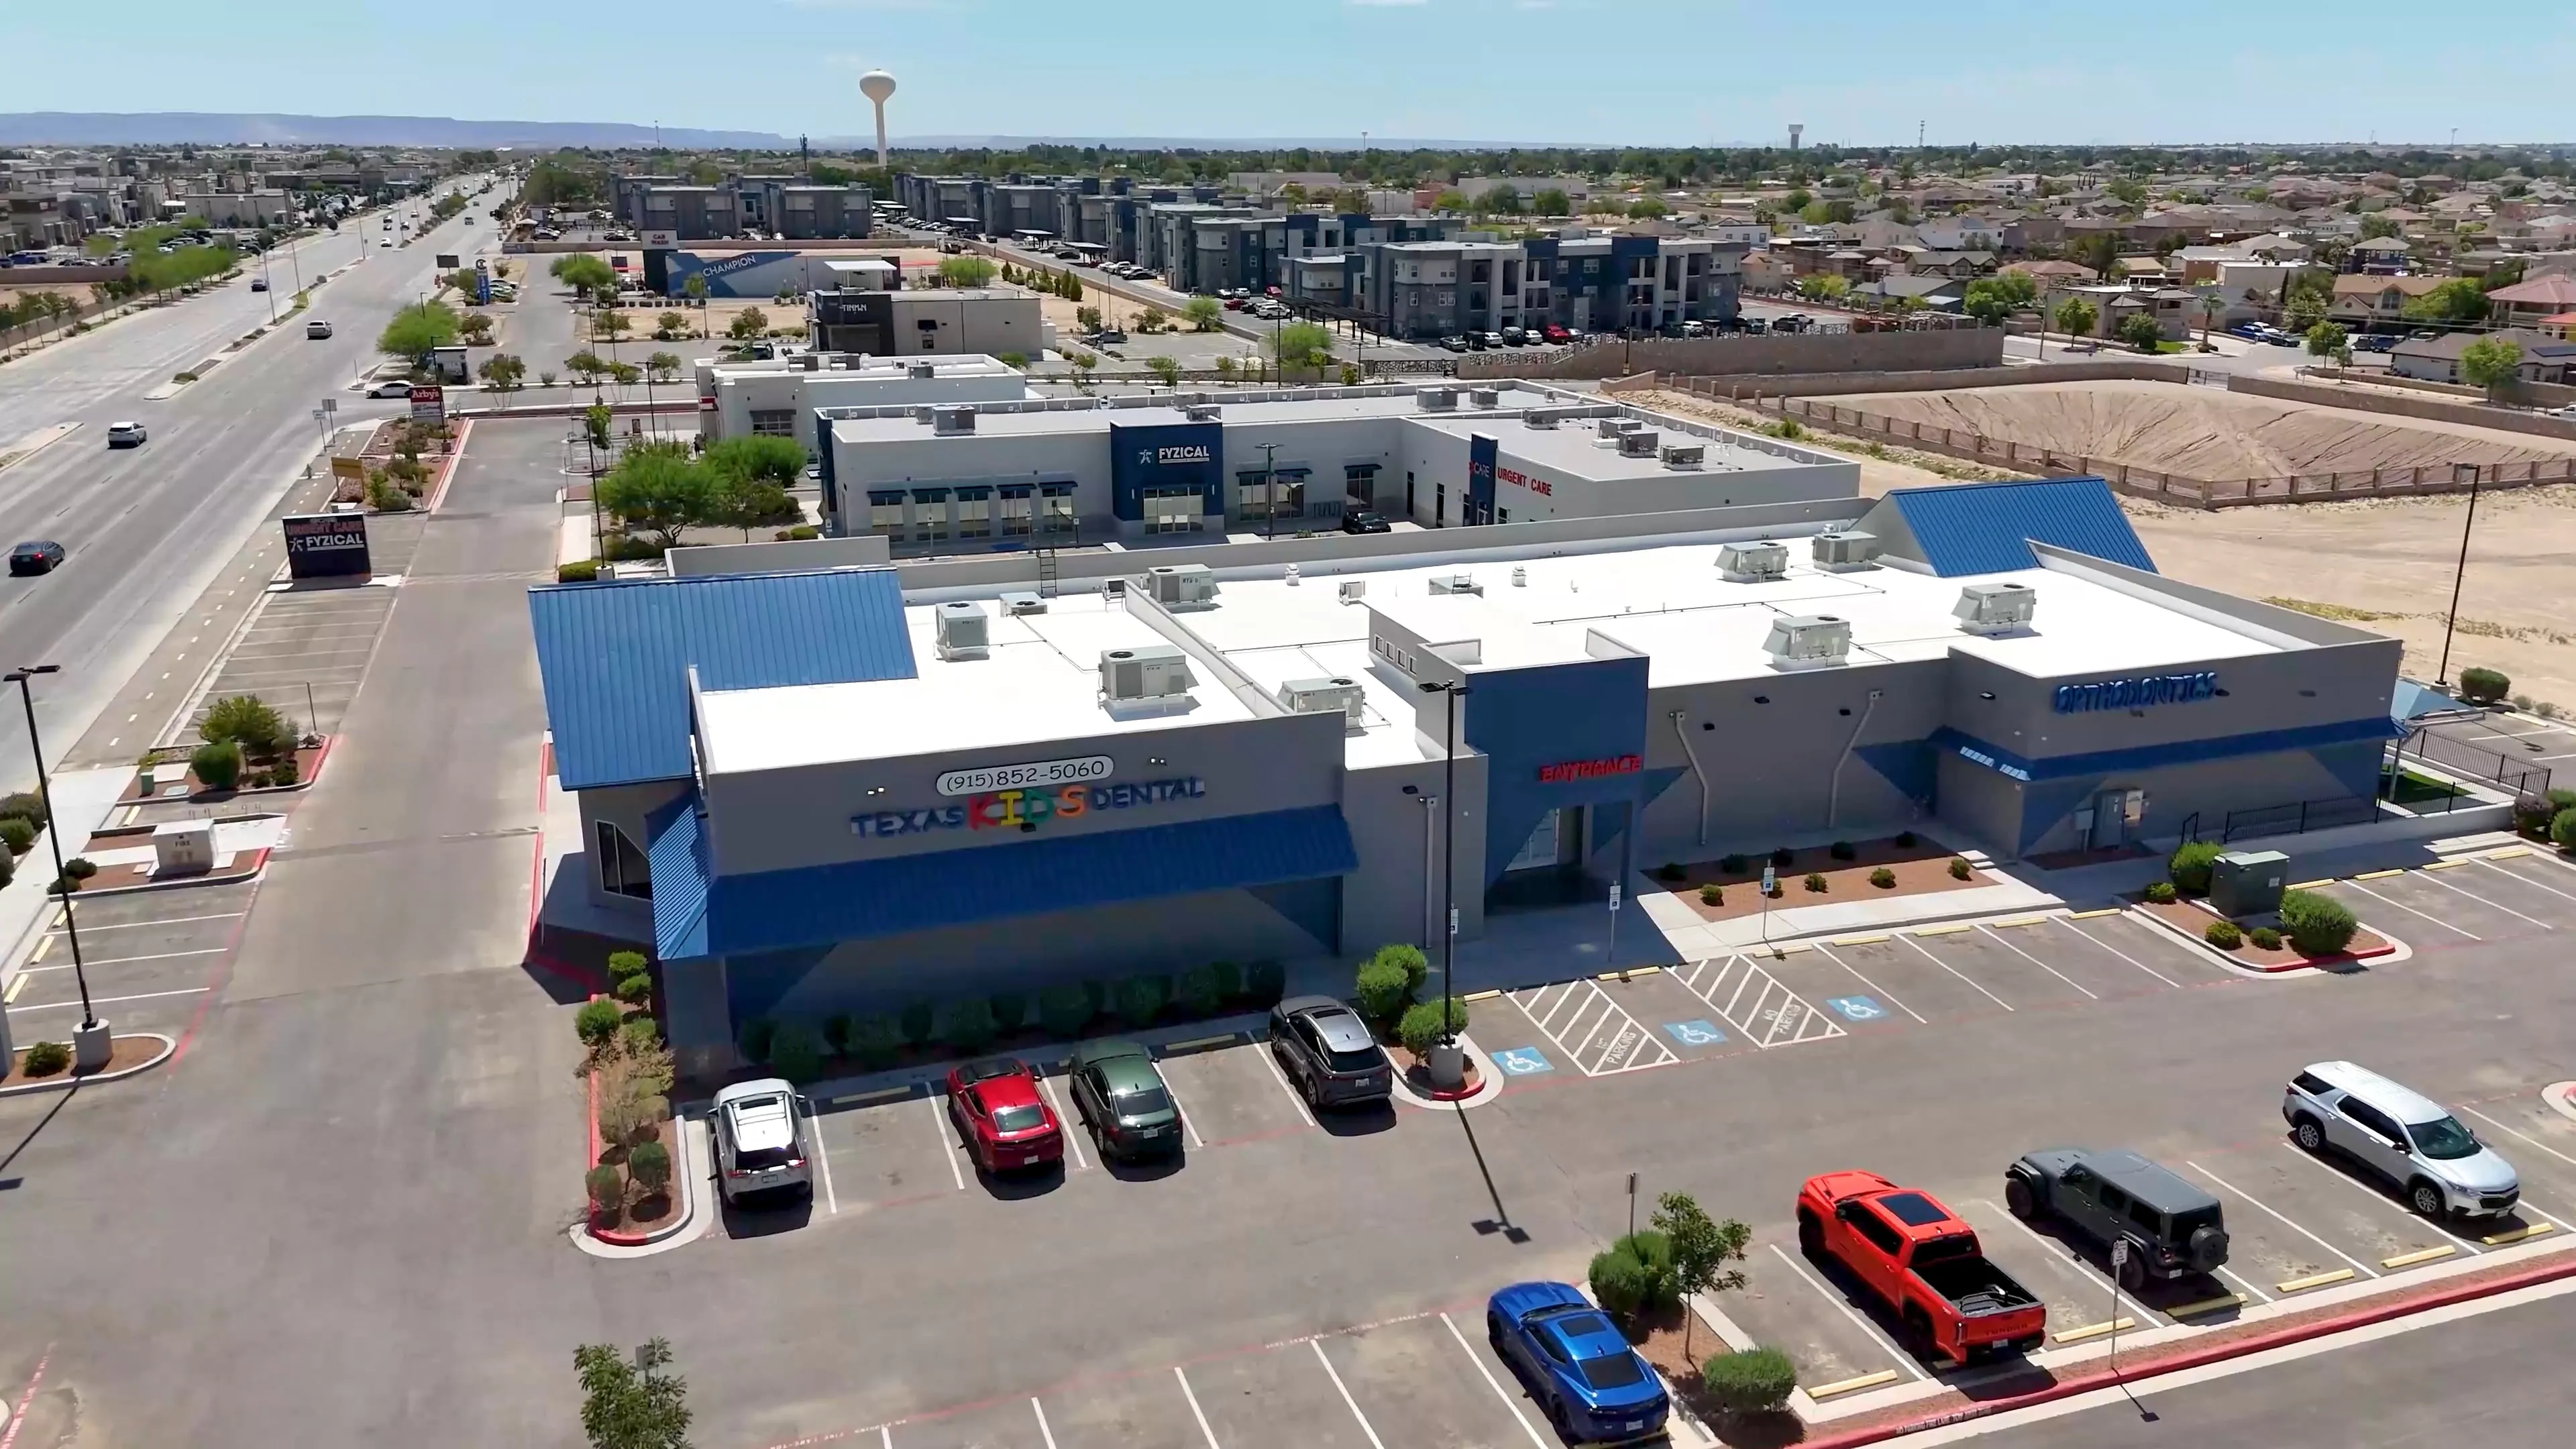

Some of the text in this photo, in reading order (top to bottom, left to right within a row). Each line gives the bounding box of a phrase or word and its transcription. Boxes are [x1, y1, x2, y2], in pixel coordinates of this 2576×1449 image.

[702, 255, 756, 277] CHAMPION
[1159, 445, 1210, 459] FYZICAL
[1497, 467, 1552, 496] URGENT CARE
[306, 533, 364, 547] FYZICAL
[2054, 672, 2216, 714] ORTHODONTICS
[1539, 753, 1643, 782] ENTRANCE
[849, 776, 1205, 839] TEXAS KIDS DENTAL
